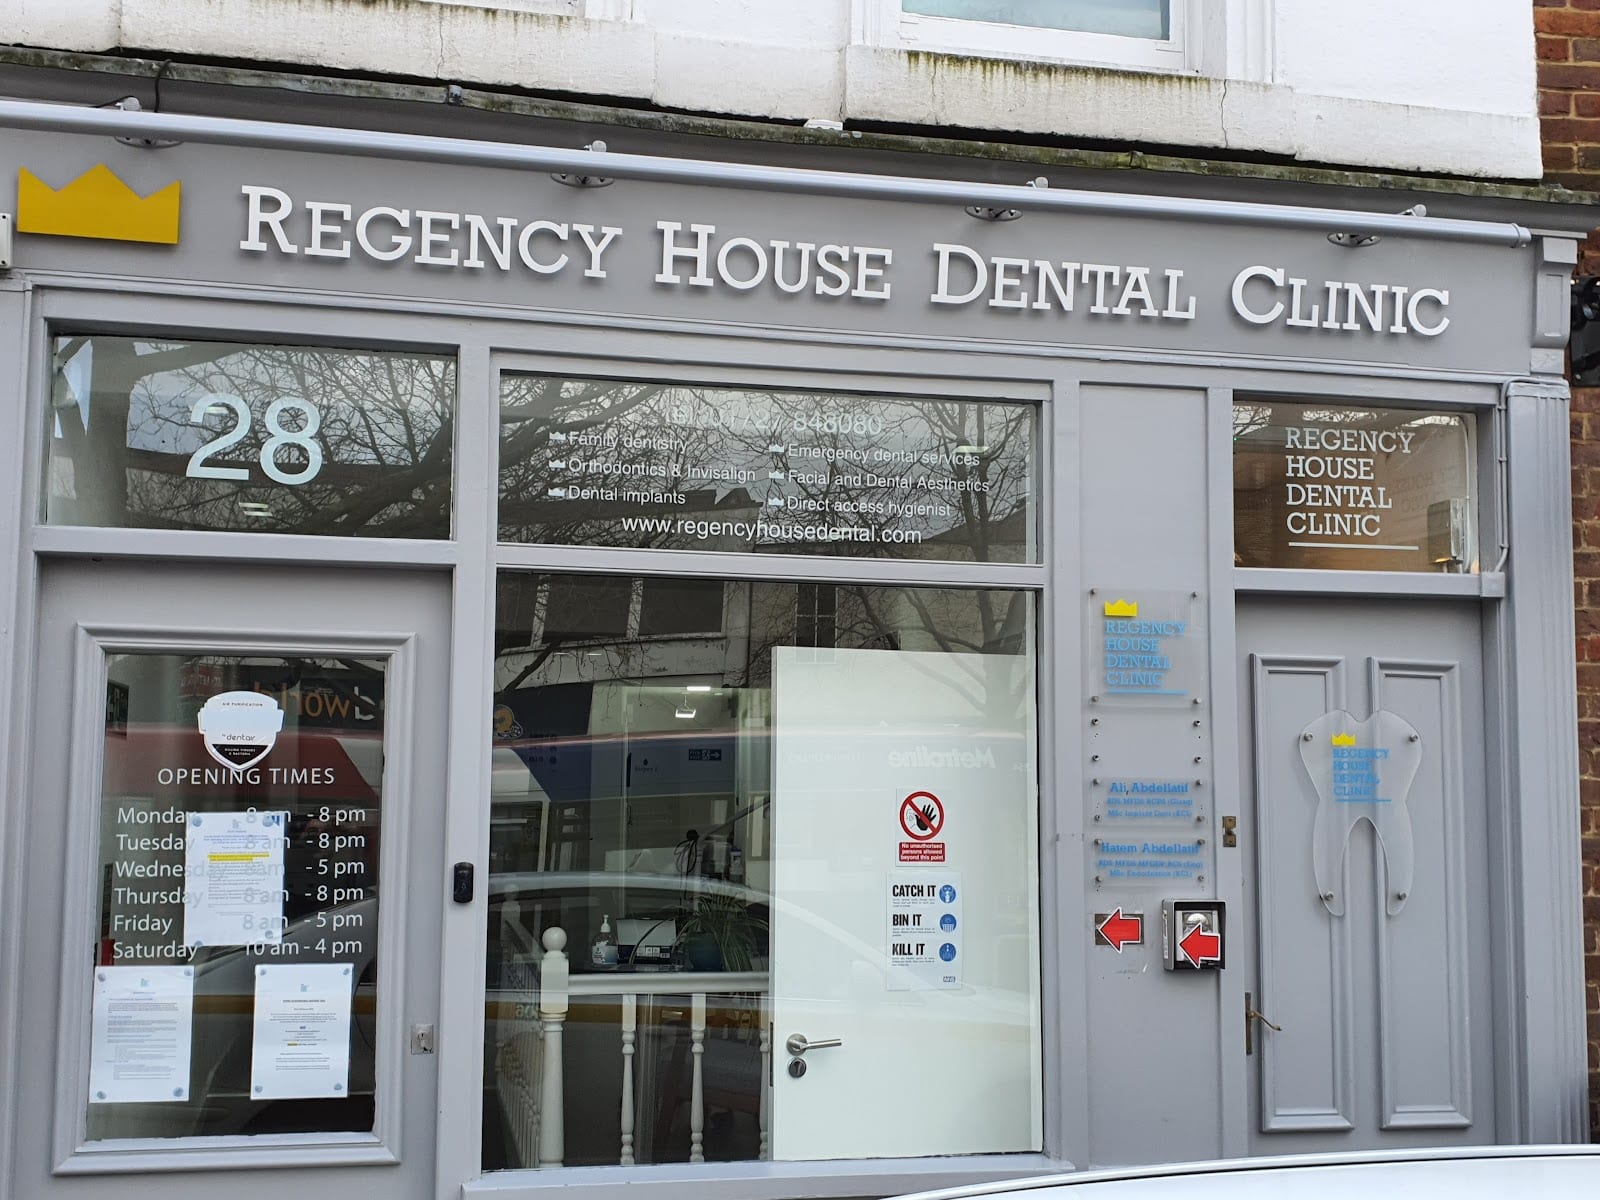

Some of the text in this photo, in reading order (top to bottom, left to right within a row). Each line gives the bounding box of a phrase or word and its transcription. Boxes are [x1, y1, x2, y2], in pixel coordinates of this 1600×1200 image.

[240, 184, 1451, 337] REGENCY HOUSE DENTAL CLINIC
[793, 410, 882, 435] 848080
[186, 392, 323, 485] 28
[568, 432, 688, 454] Family dentistry
[1285, 426, 1415, 453] REGENCY
[788, 443, 980, 466] Emergency dental services
[568, 458, 756, 484] Orthodontics & Invisalign
[1285, 455, 1374, 480] HOUSE
[788, 470, 990, 492] Facial and Dental Aesthetics
[568, 485, 686, 505] Dental implants
[1286, 483, 1392, 509] DENTAL
[787, 496, 951, 518] Direct access hygienist
[622, 517, 922, 543] www.regencyhousedental.com
[1286, 512, 1381, 537] CLINIC
[1104, 620, 1187, 635] REGENCY
[1105, 637, 1162, 652] HOUSE
[1106, 654, 1172, 670] DENTAL
[1106, 671, 1166, 686] CLINIC
[157, 768, 335, 785] OPENING TIMES
[246, 807, 257, 824] 8
[319, 807, 330, 823] 8
[335, 809, 366, 826] pm
[245, 835, 256, 850] 8
[262, 837, 290, 849] am
[318, 833, 329, 849] 8
[334, 835, 365, 852] pm
[317, 860, 328, 875] 5
[334, 861, 364, 878] pm
[114, 887, 203, 908] Thursday
[243, 887, 254, 903] 8
[259, 889, 289, 902] am
[316, 885, 328, 901] 8
[333, 888, 364, 905] pm
[892, 884, 936, 897] CATCH IT
[114, 914, 173, 935] Friday
[243, 914, 254, 930] 8
[258, 916, 289, 929] am
[316, 912, 327, 928] 5
[332, 914, 363, 931] pm
[892, 914, 922, 926] BIN IT
[113, 940, 198, 960] Saturday
[245, 941, 265, 956] 10
[270, 942, 299, 956] am
[315, 939, 327, 954] 4
[332, 941, 362, 958] pm
[892, 943, 925, 956] KILL IT
